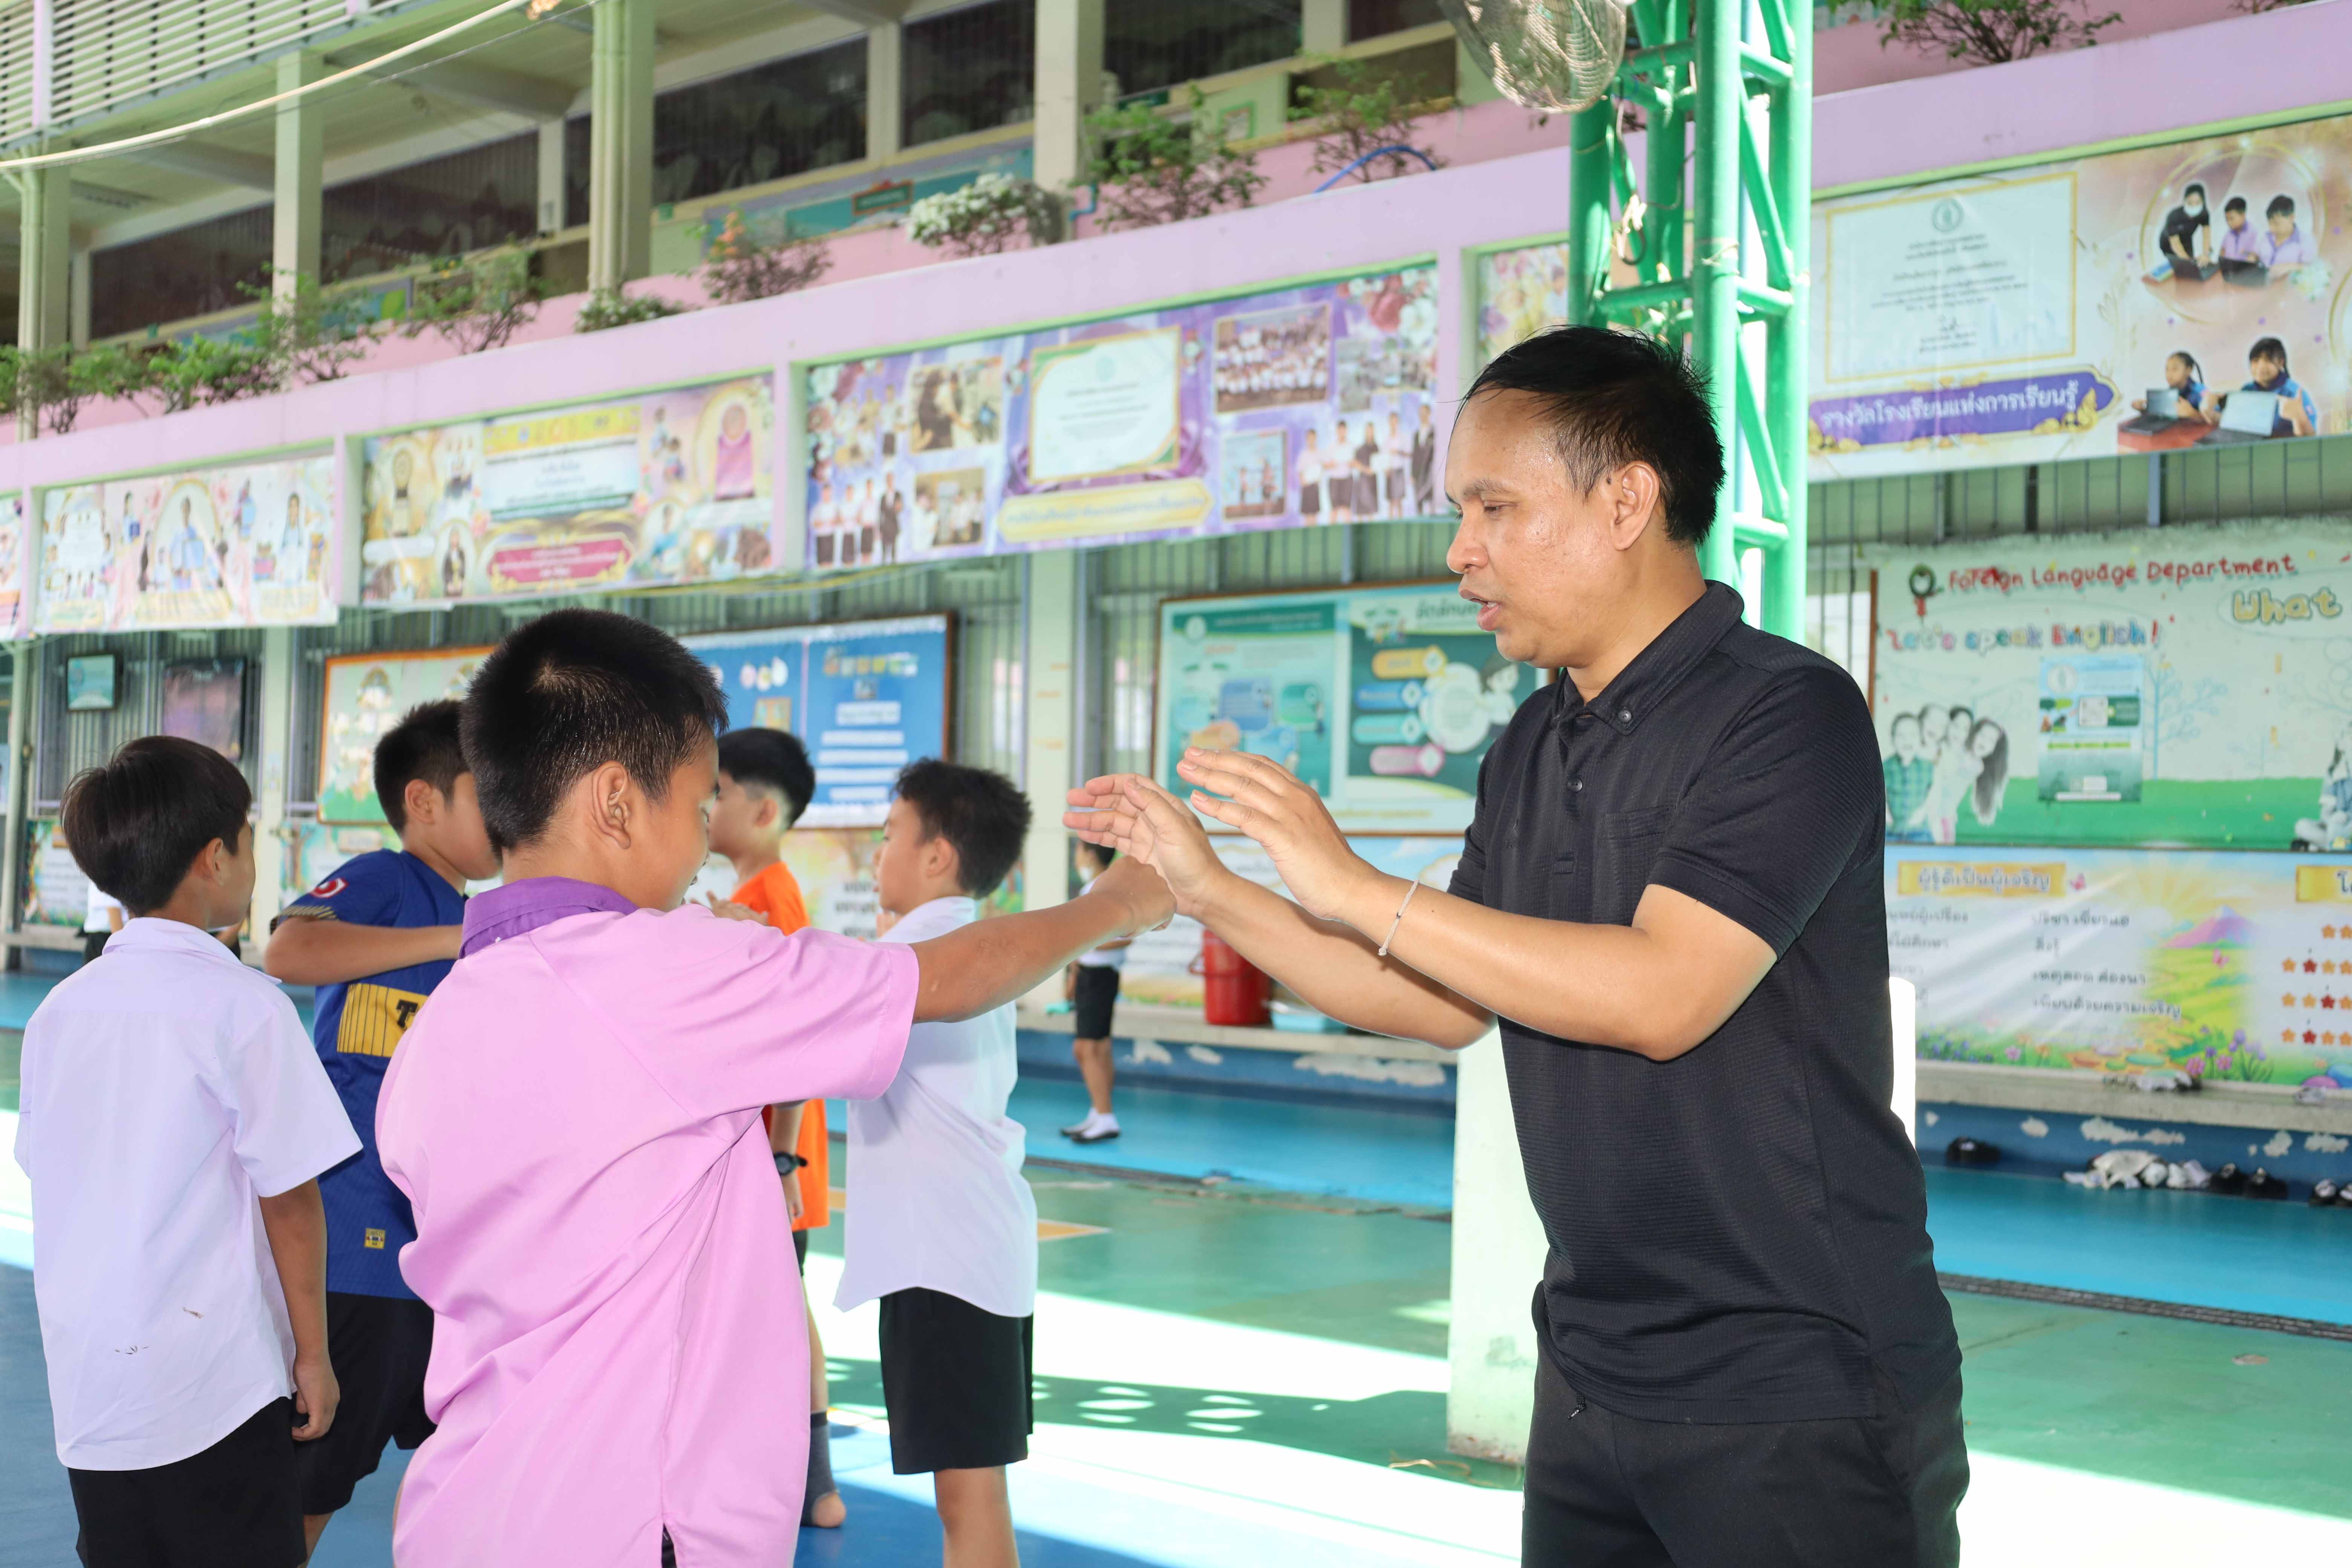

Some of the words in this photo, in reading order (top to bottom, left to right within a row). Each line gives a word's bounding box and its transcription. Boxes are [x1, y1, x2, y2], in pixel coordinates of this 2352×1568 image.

[1822, 379, 2078, 428] รางวัลโรงเรียนแห่งการเรียนรู้
[2032, 563, 2136, 588] Language
[2147, 554, 2294, 586] Department
[2232, 586, 2342, 624] What
[1965, 624, 2043, 657] speak
